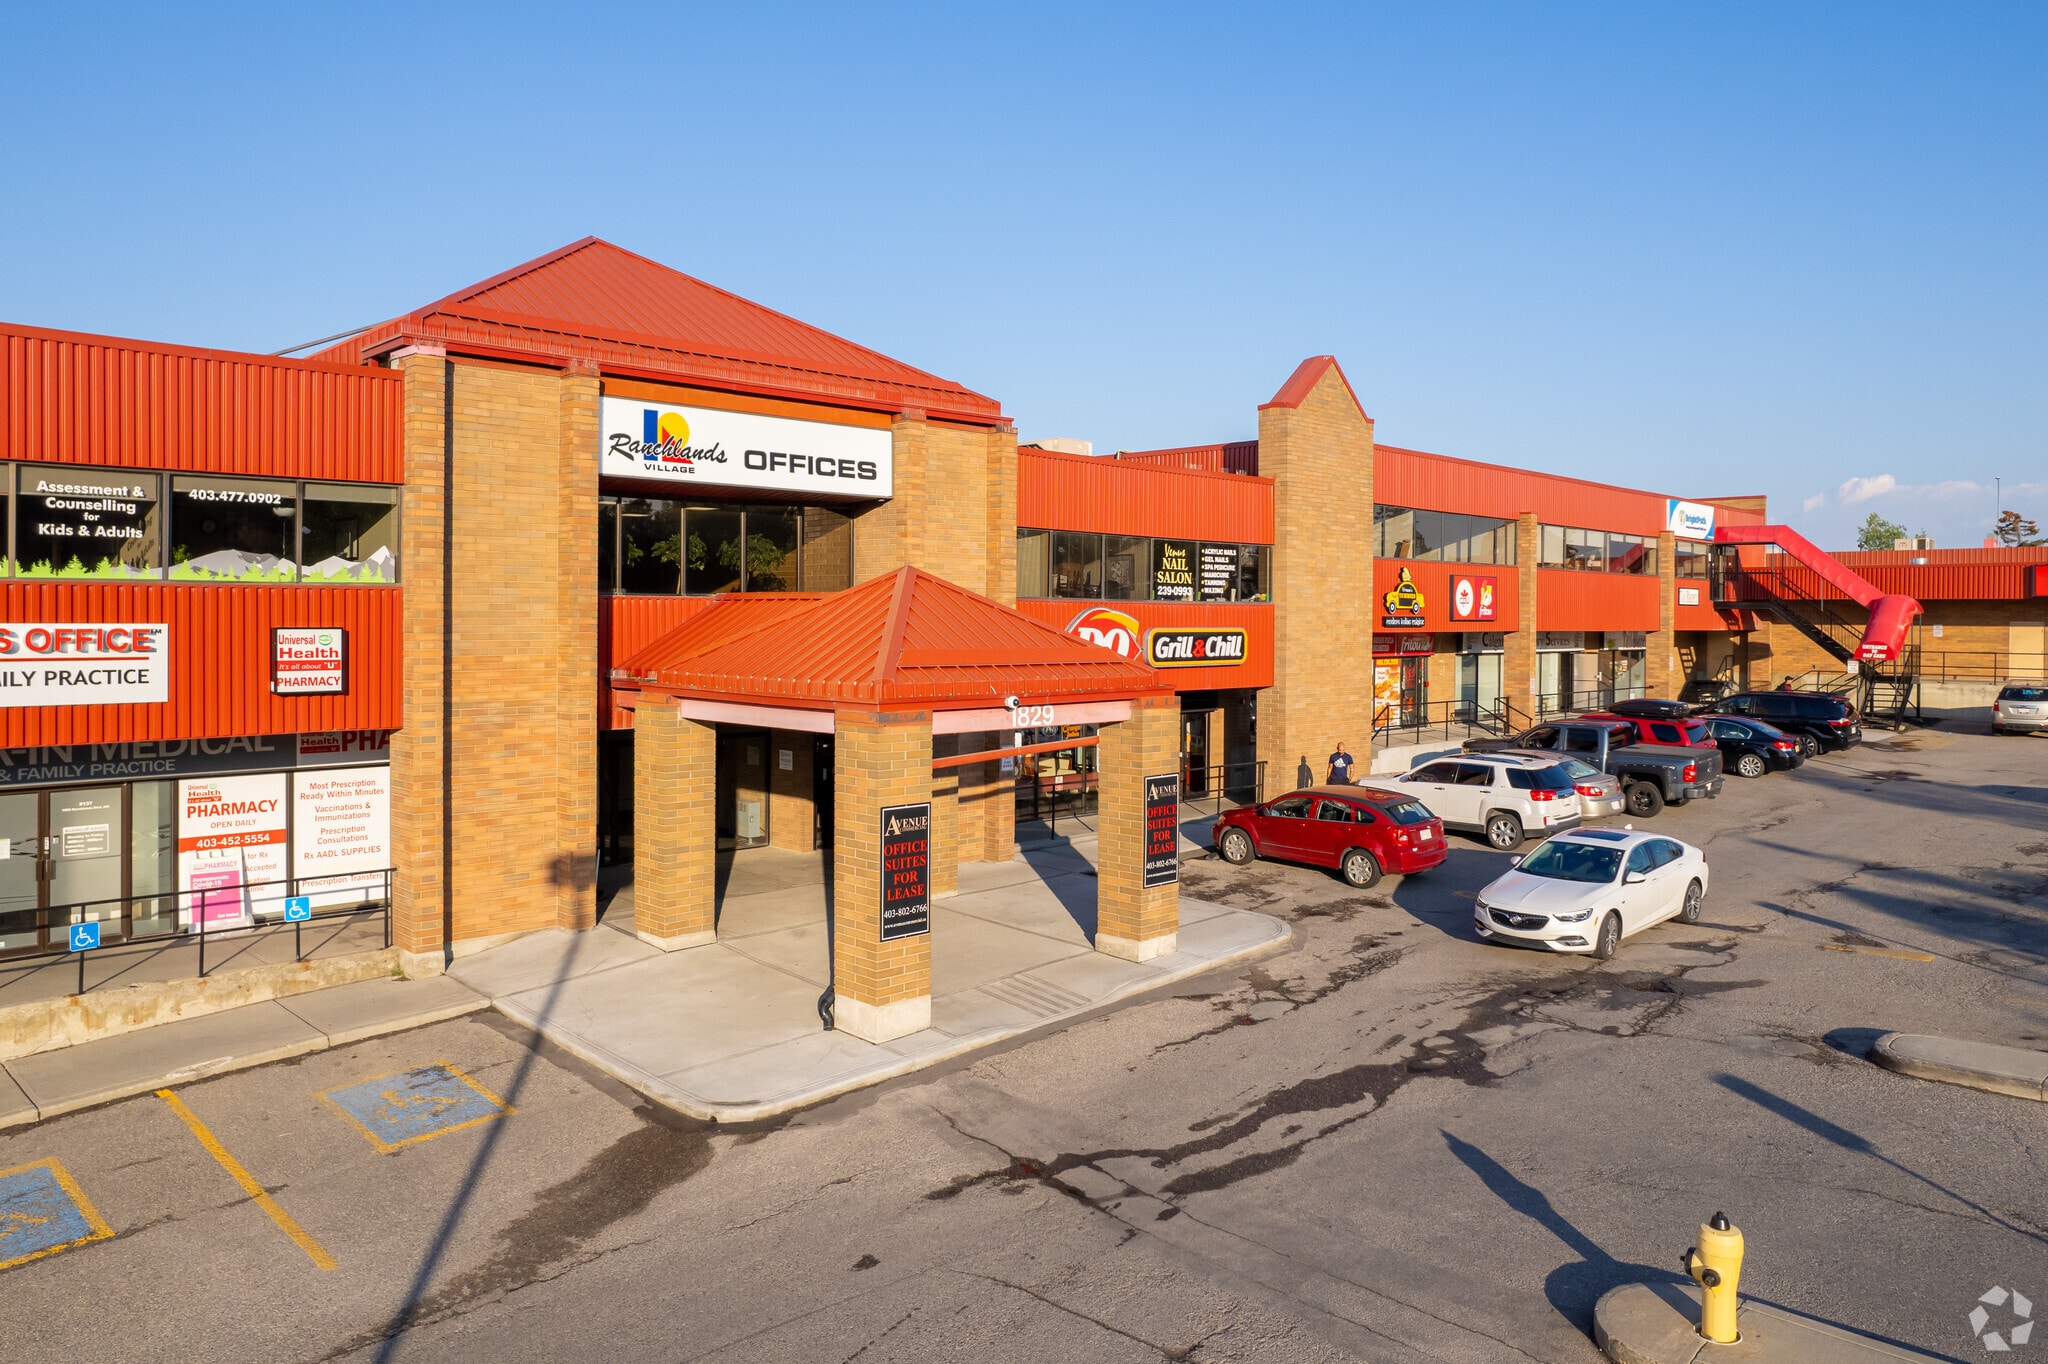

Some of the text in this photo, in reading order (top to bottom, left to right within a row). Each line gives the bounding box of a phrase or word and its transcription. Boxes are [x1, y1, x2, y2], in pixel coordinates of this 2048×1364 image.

[608, 433, 728, 464] Ranchlands
[644, 463, 696, 474] VILLAGE
[744, 449, 878, 481] OFFICES
[36, 480, 145, 497] Assessment &
[189, 489, 281, 505] 403.477.0902
[45, 497, 137, 515] Counselling
[84, 512, 100, 521] for
[38, 523, 144, 538] Kids & Adults
[1162, 558, 1188, 570] NAIL
[1157, 571, 1192, 584] SALON
[1157, 586, 1192, 596] 239-0993
[25, 628, 151, 652] OFFICE
[278, 634, 316, 645] Universal
[1155, 635, 1243, 658] Grill & Chill
[279, 647, 339, 658] Health
[0, 669, 150, 687] ILY PRACTICE
[276, 676, 341, 687] PHARMACY
[1012, 705, 1054, 728] 1829
[91, 734, 275, 762] MEDICAL
[301, 737, 339, 747] Health
[18, 765, 85, 780] FAMILY
[90, 759, 176, 776] PRACTICE
[331, 779, 376, 788] Prescription
[300, 788, 384, 802] Ready Within Minutes
[1147, 783, 1177, 800] AVENUE
[187, 799, 278, 818] PHARMACY
[315, 803, 363, 812] Vaccinations
[1147, 804, 1177, 818] OFFICE
[211, 819, 256, 829] OPEN DAILY
[315, 812, 371, 822] Immunizations
[1147, 817, 1176, 830] SUITES
[320, 826, 366, 835] Prescription
[884, 815, 928, 836] AVENUE
[196, 833, 270, 848] 403-452-5554
[317, 835, 368, 845] Consultations
[1153, 830, 1171, 842] FOR
[317, 850, 338, 859] AADL
[341, 845, 381, 856] SUPPLIES
[884, 839, 928, 856] OFFICE
[1148, 841, 1175, 855] LEASE
[204, 861, 238, 869] PHARMACY
[246, 863, 276, 872] Accepted
[885, 854, 926, 871] SUITES
[302, 872, 383, 887] Prescription Transfers
[893, 871, 918, 885] FOR
[887, 884, 925, 901] LEASE
[884, 903, 928, 919] 403-802-6766
